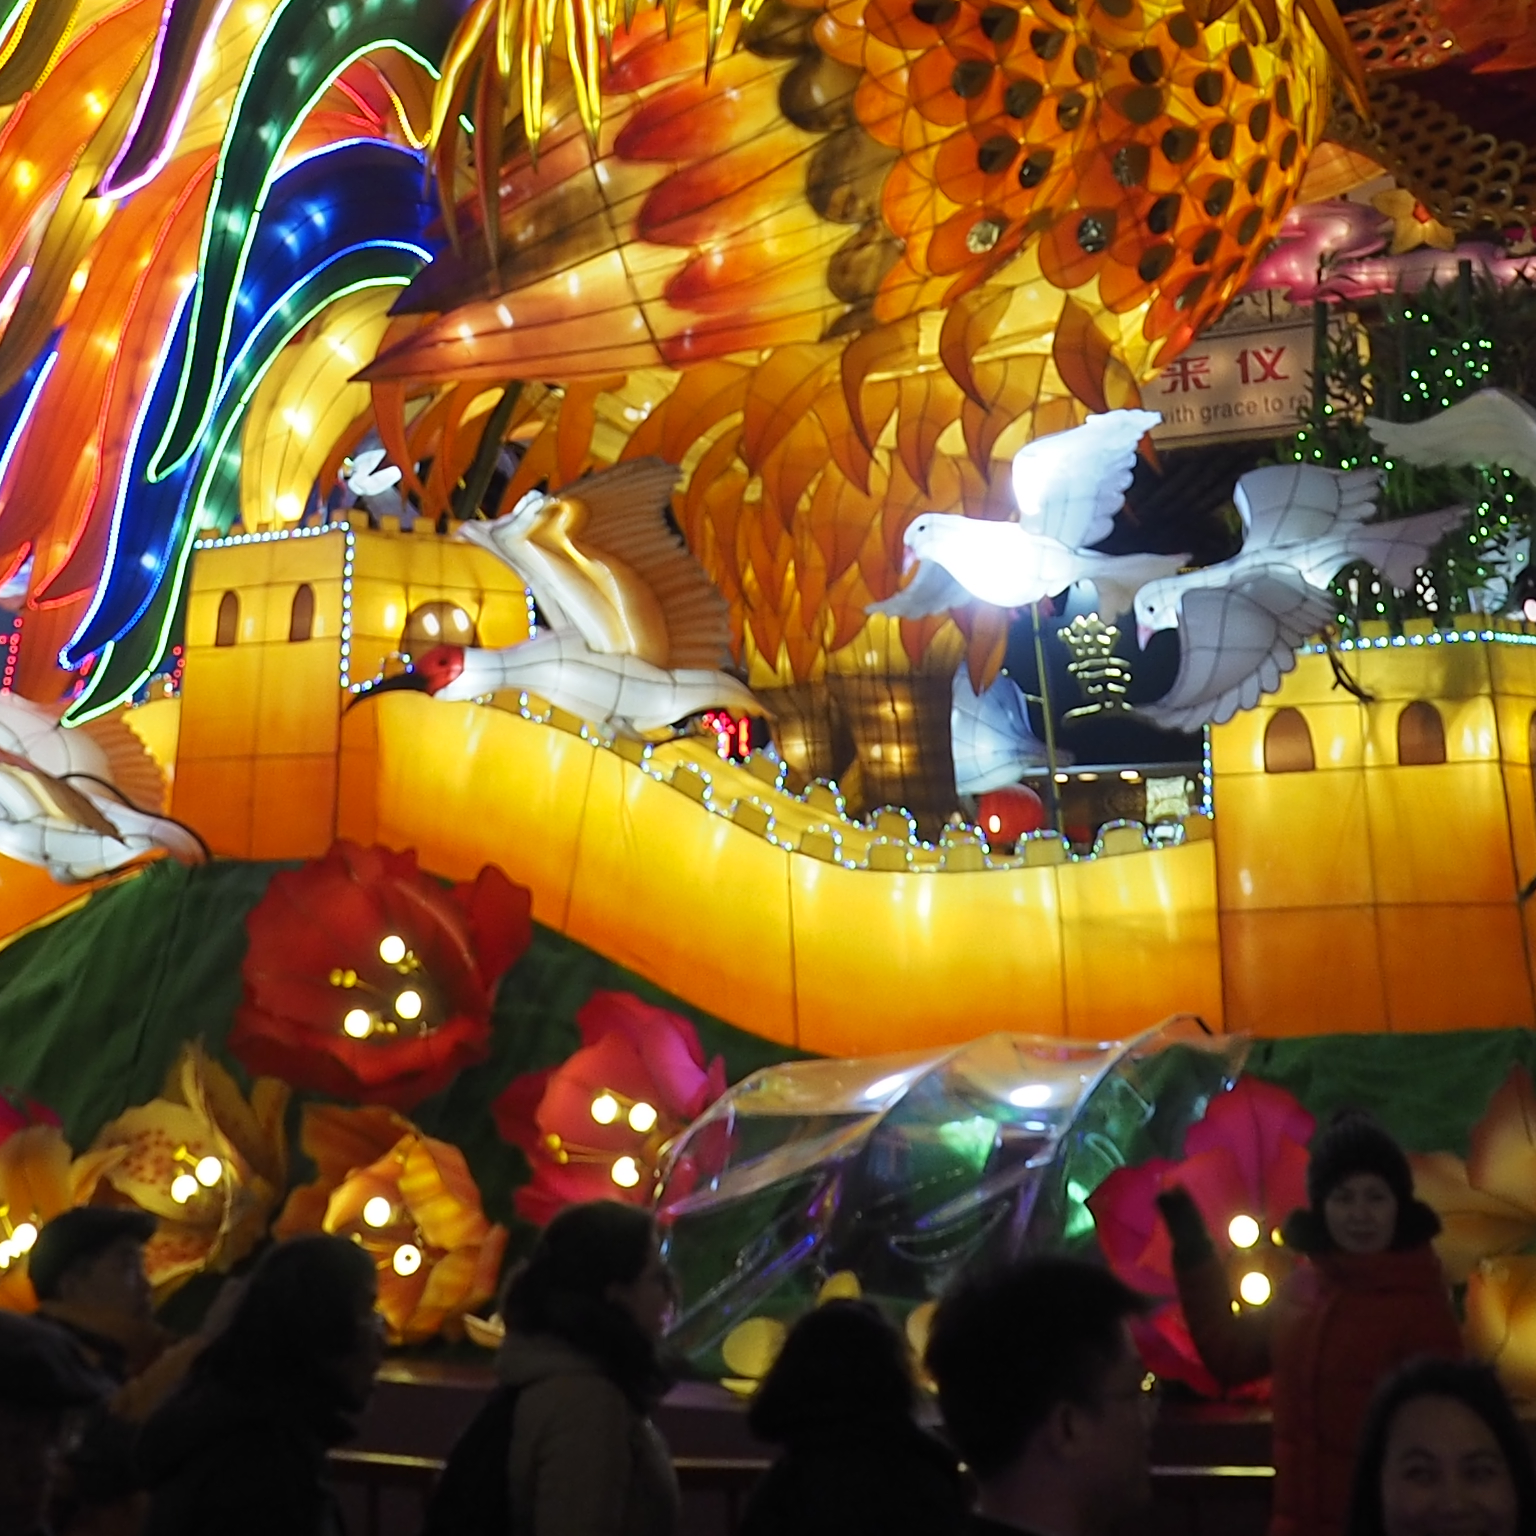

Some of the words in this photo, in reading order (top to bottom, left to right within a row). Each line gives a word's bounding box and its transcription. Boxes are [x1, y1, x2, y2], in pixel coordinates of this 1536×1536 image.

[1161, 346, 1289, 394] 来仪
[1200, 399, 1258, 424] grace
[1263, 395, 1284, 412] to
